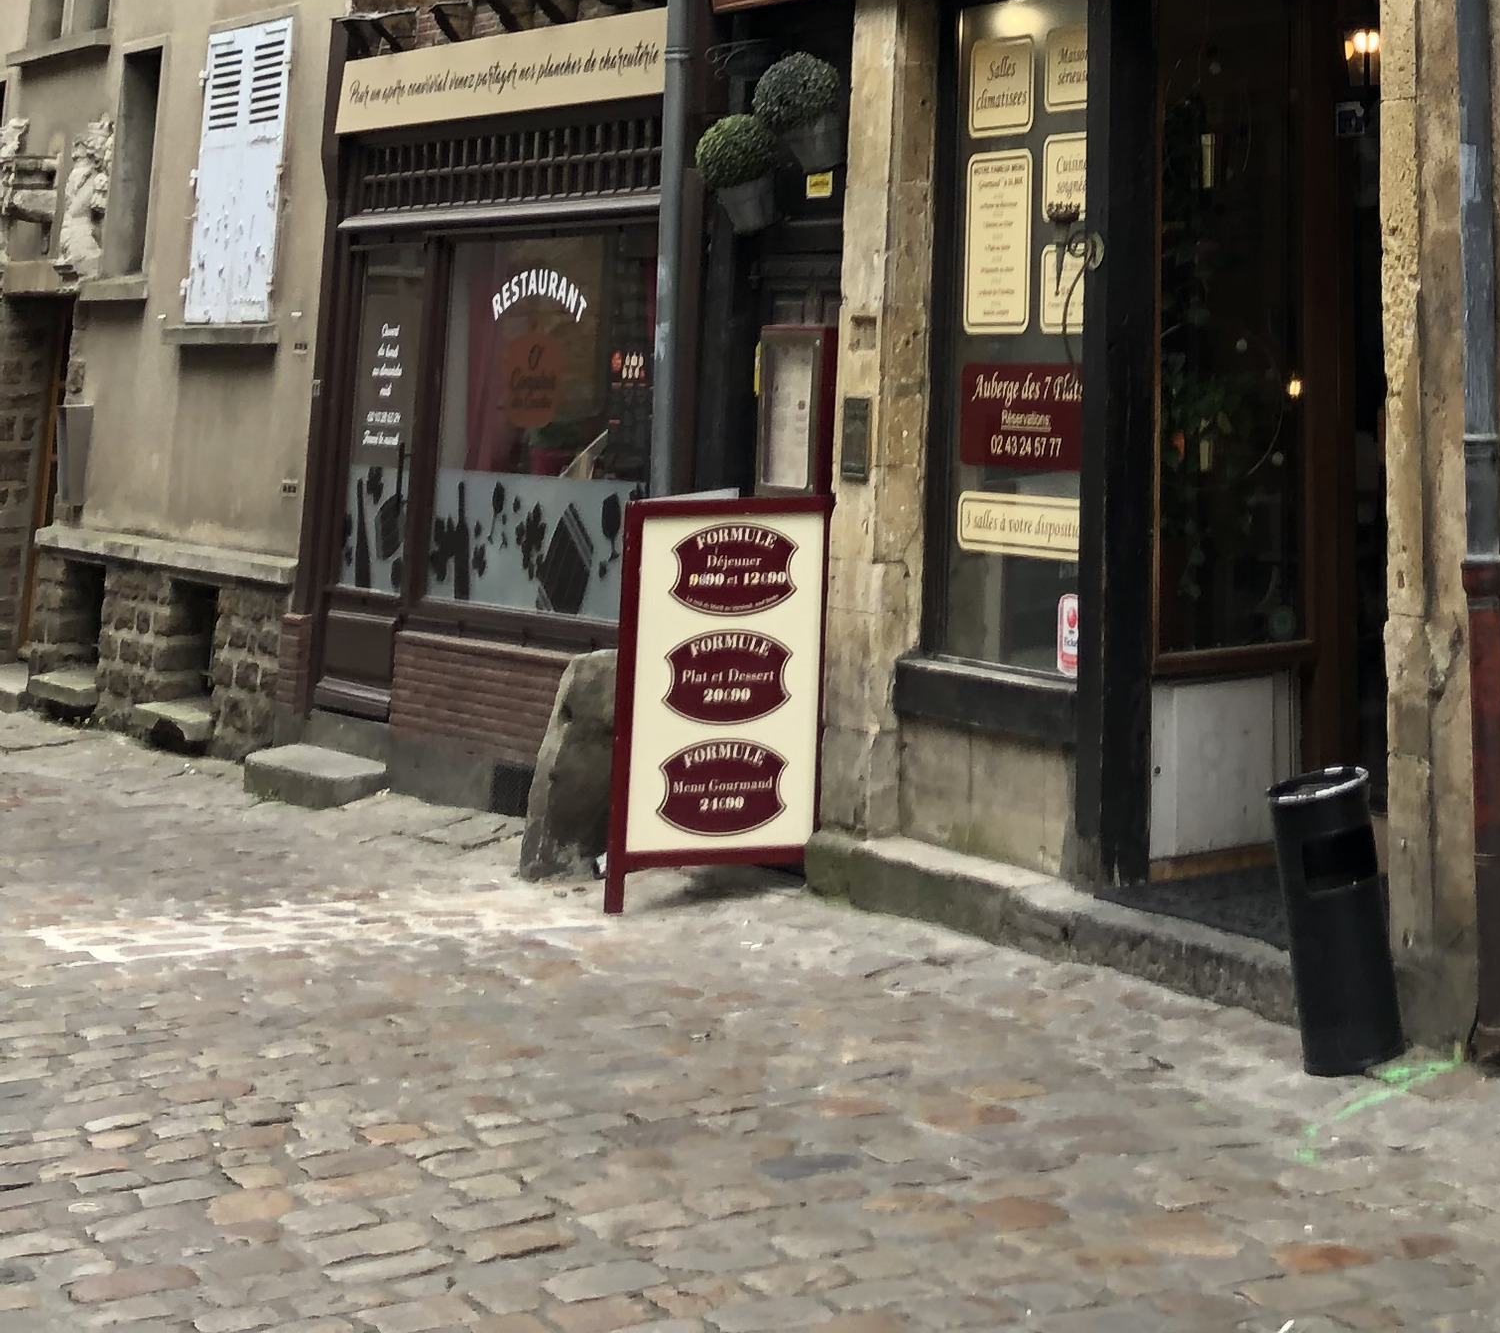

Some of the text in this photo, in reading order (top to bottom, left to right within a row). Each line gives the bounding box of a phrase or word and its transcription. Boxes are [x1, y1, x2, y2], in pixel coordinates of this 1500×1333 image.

[987, 55, 1017, 81] Salles
[492, 268, 588, 323] RESTAURANT
[971, 371, 1019, 407] Auberge
[1021, 372, 1041, 401] des
[1043, 375, 1053, 402] 7
[990, 434, 1003, 455] 02
[1004, 435, 1018, 456] 43
[1019, 436, 1032, 456] 24
[1049, 437, 1062, 458] 77
[973, 509, 998, 532] salles
[1008, 517, 1033, 535] votre
[1034, 513, 1079, 543] dispositio
[696, 527, 778, 550] FORMULE
[706, 554, 762, 571] Déjeuner
[727, 574, 739, 588] et
[689, 634, 773, 658] FORMULE
[681, 667, 776, 684] Plat et Dessert
[682, 743, 767, 769] FORMULE
[672, 776, 774, 794] Menu Gourmand
